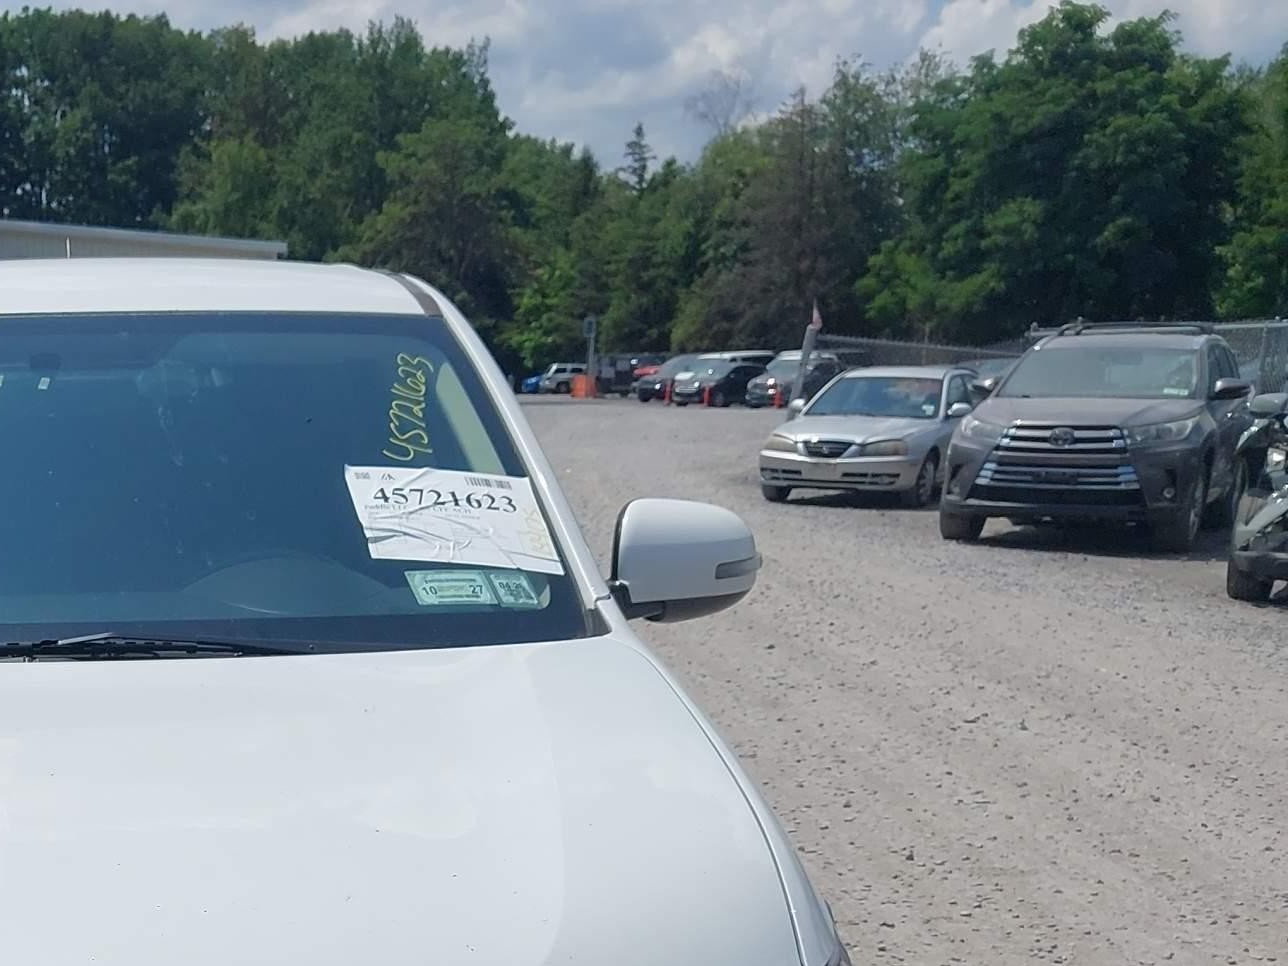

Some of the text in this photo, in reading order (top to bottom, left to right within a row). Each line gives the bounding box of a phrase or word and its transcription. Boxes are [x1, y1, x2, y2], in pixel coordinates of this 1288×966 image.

[382, 352, 434, 461] 45721623
[373, 487, 518, 514] 45721623
[422, 584, 483, 596] 10 27
